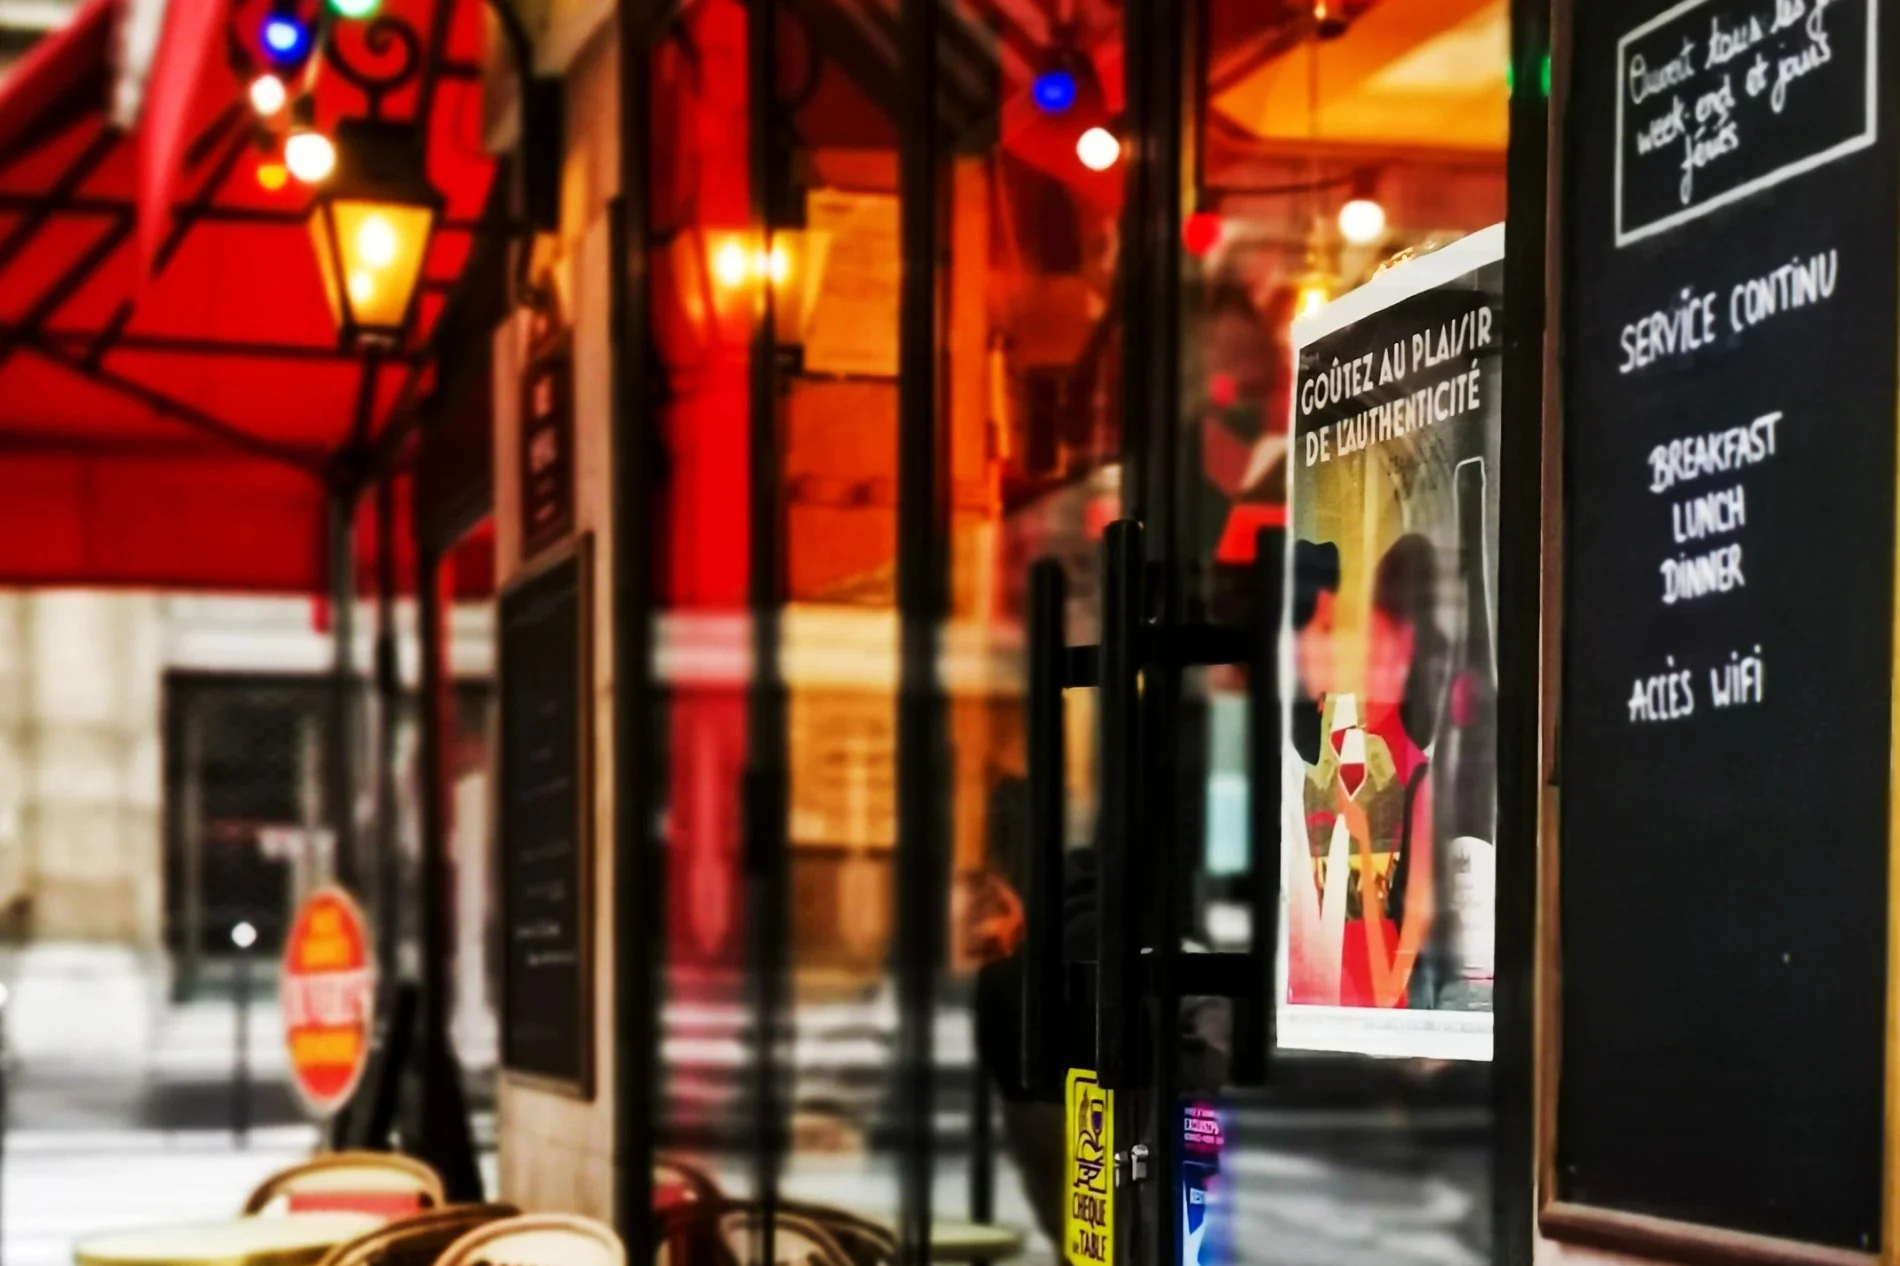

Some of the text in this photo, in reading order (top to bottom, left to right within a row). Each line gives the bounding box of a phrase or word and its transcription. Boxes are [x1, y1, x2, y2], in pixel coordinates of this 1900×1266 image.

[1301, 306, 1493, 416] GOÛTEZ AU PLAISIR
[1306, 358, 1481, 467] DE L'AUTHENTICITÉ
[1648, 411, 1783, 493] BREAKFAST
[1672, 485, 1746, 544] LUNCH
